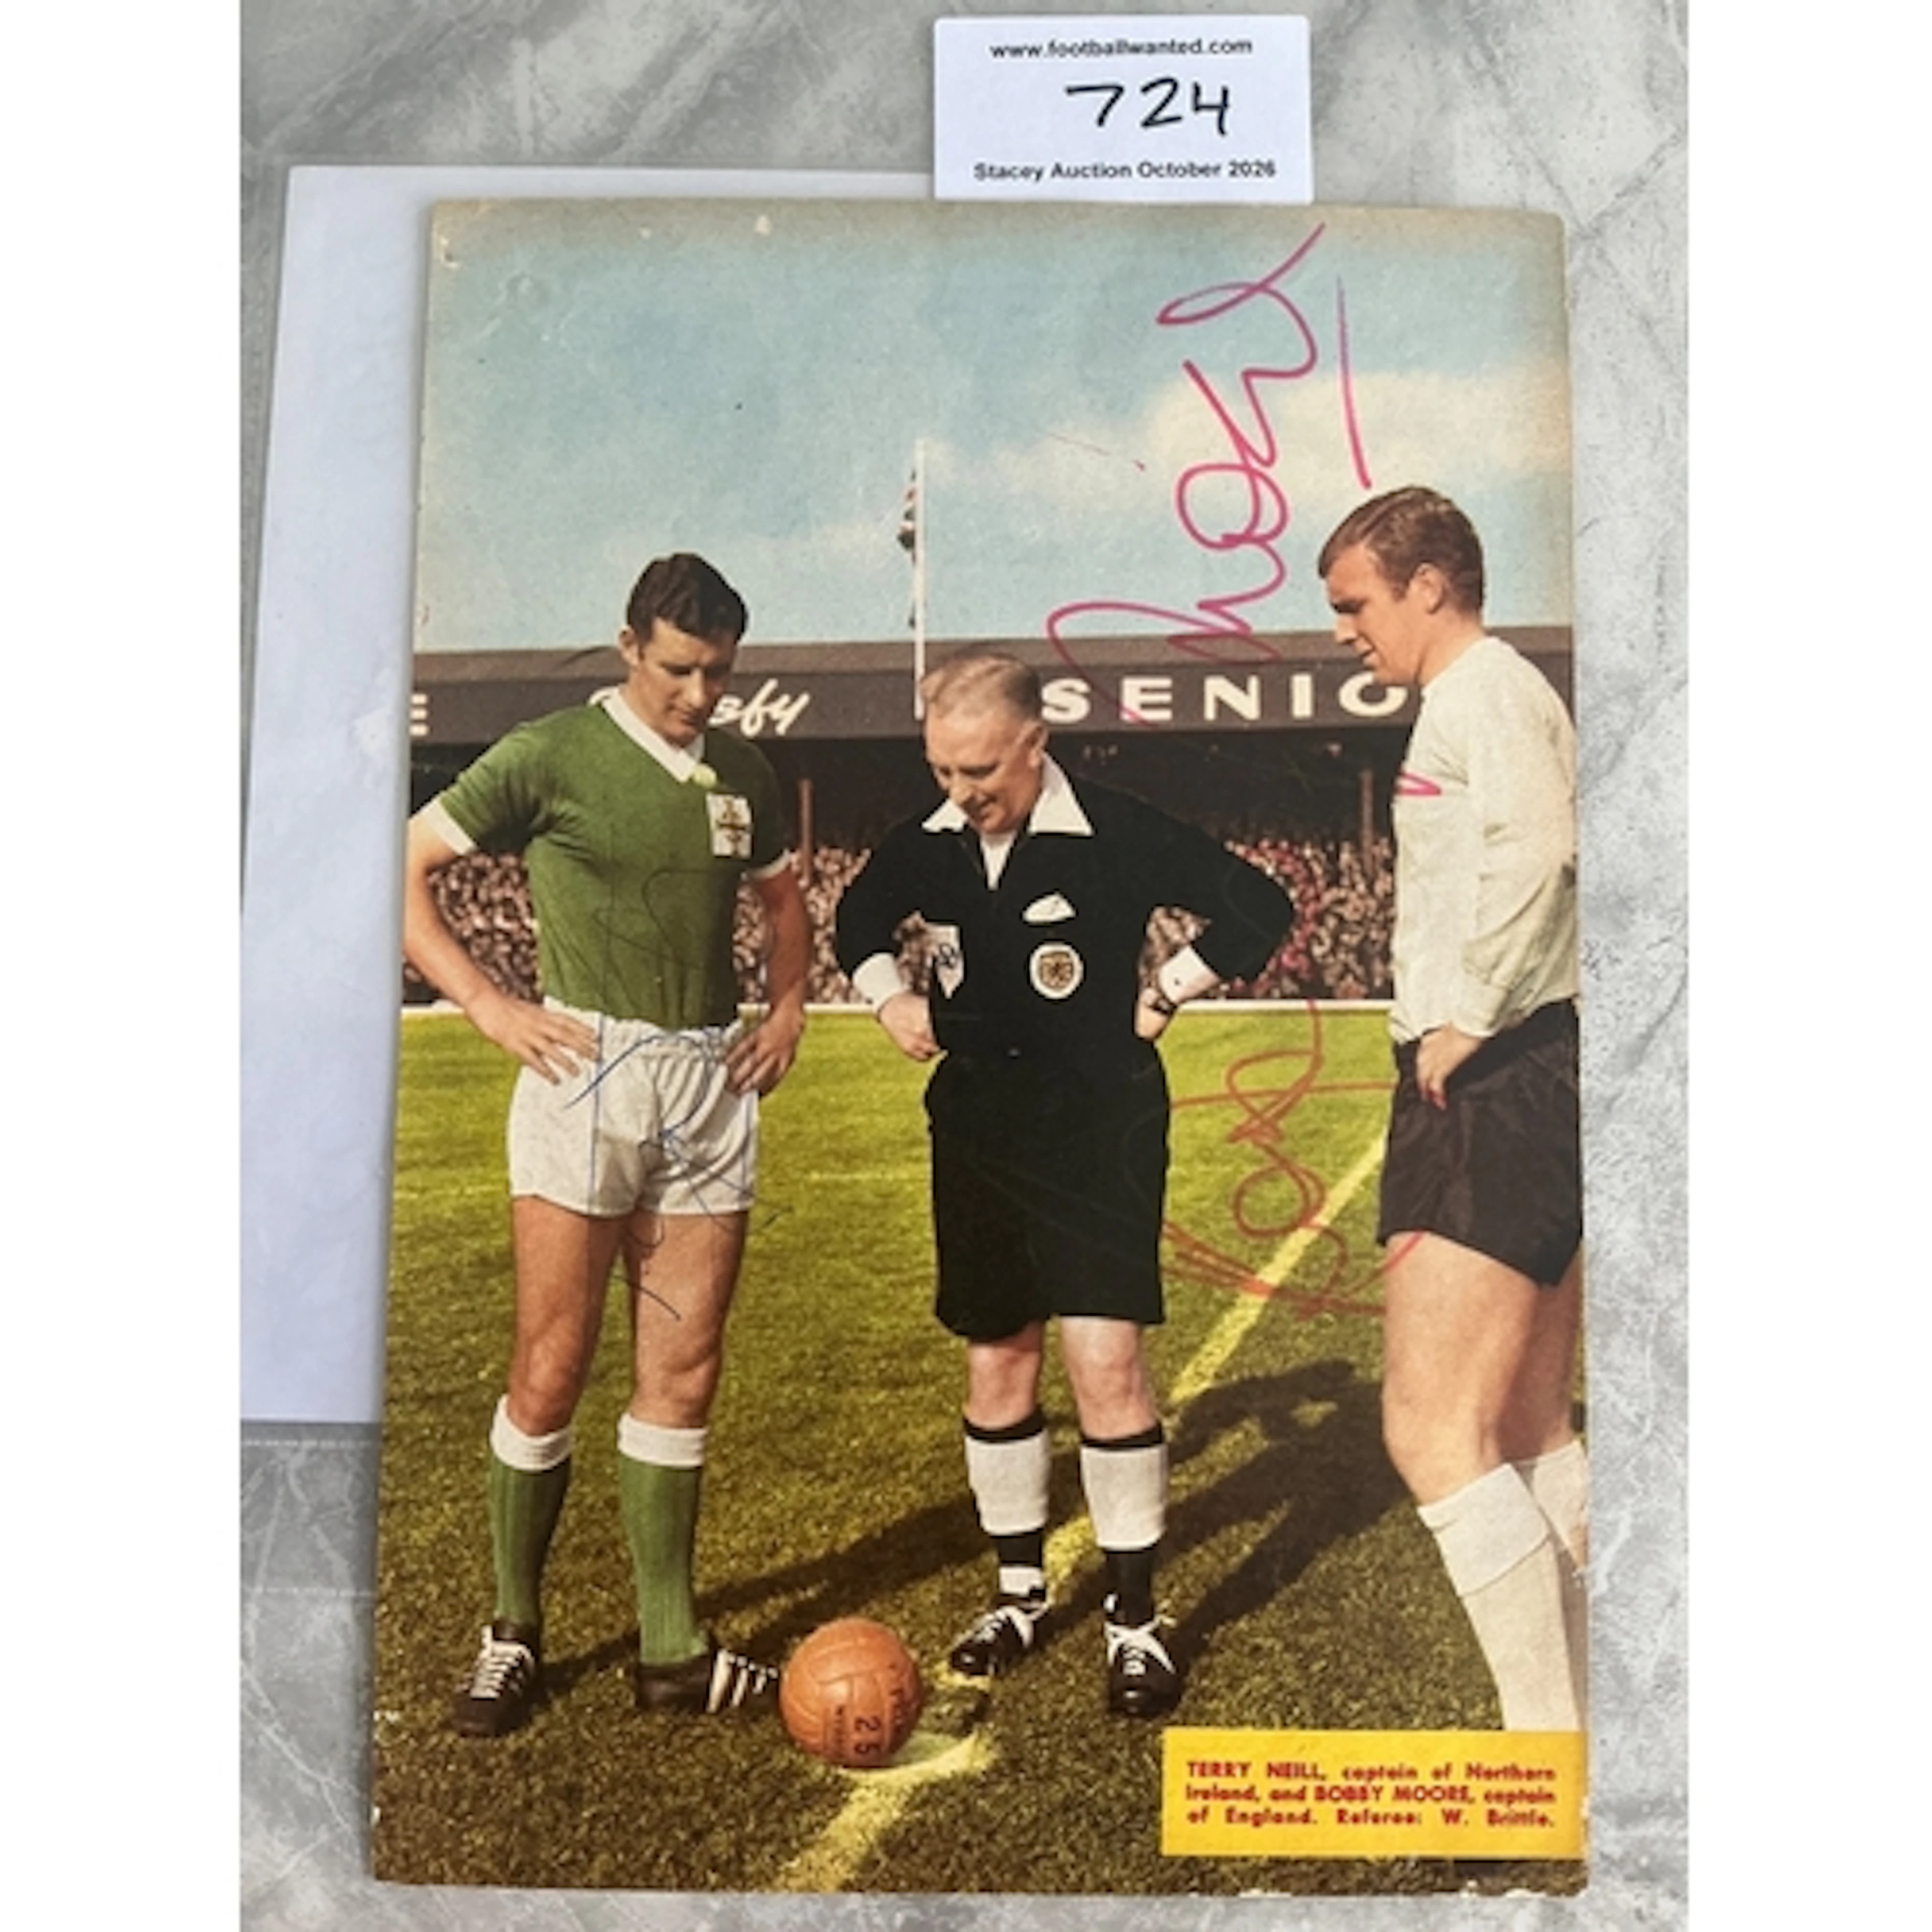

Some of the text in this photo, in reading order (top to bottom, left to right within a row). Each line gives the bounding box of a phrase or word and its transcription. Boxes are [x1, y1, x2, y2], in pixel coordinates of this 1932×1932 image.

[990, 39, 1252, 59] www.footballwanted.com
[1066, 76, 1230, 136] 724
[974, 162, 1042, 182] Stacey
[1051, 162, 1132, 178] Auction
[1137, 161, 1221, 178] October
[1041, 673, 1408, 723] SENIO
[1187, 1761, 1555, 1783] TERRY NEILL, captain of Northern
[1186, 1784, 1555, 1807] Ireland, and BOBBY MOORE, captain
[1187, 1805, 1209, 1823] of
[1225, 1805, 1318, 1827] England.
[1336, 1808, 1423, 1825] Referee:
[1441, 1809, 1469, 1825] W.
